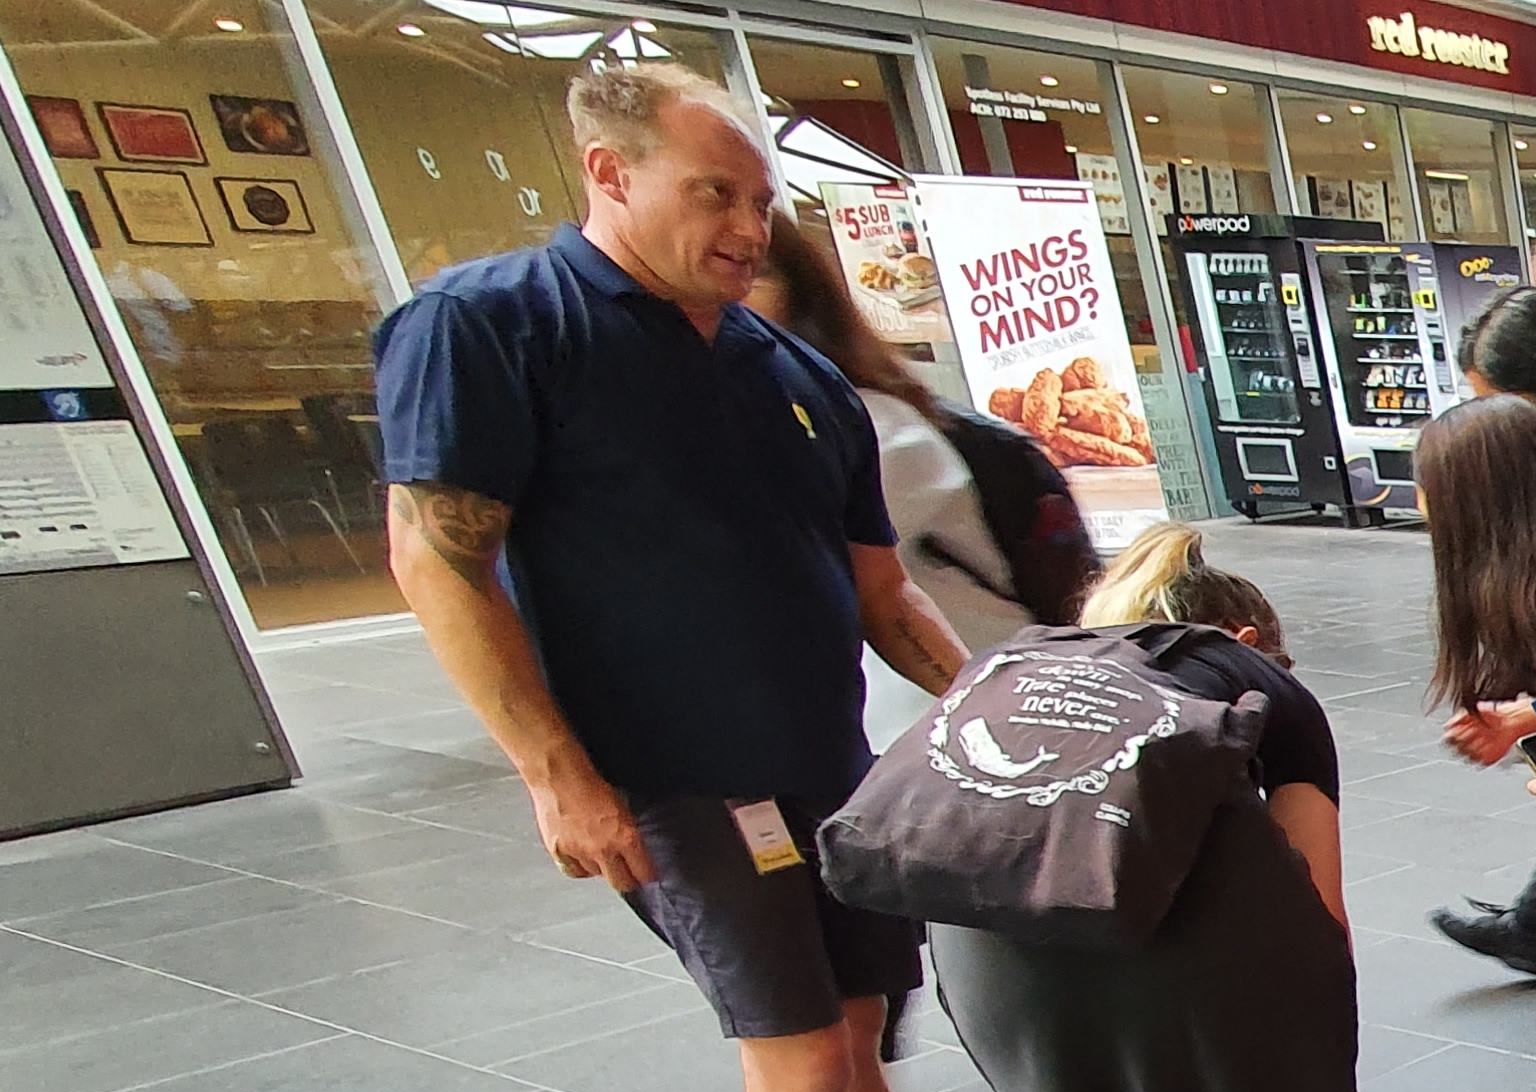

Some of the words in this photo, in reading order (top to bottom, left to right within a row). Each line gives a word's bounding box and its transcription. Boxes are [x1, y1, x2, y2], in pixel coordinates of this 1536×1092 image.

[1367, 11, 1420, 57] red
[1417, 26, 1510, 75] rooster
[860, 203, 891, 224] SUB
[1177, 214, 1250, 235] powerpod
[959, 229, 1089, 292] WINGS
[970, 286, 1013, 317] ON
[1020, 262, 1094, 301] YOUR
[979, 287, 1099, 354] MIND?
[1037, 664, 1112, 682] down
[1013, 676, 1067, 693] True
[1020, 695, 1097, 717] never
